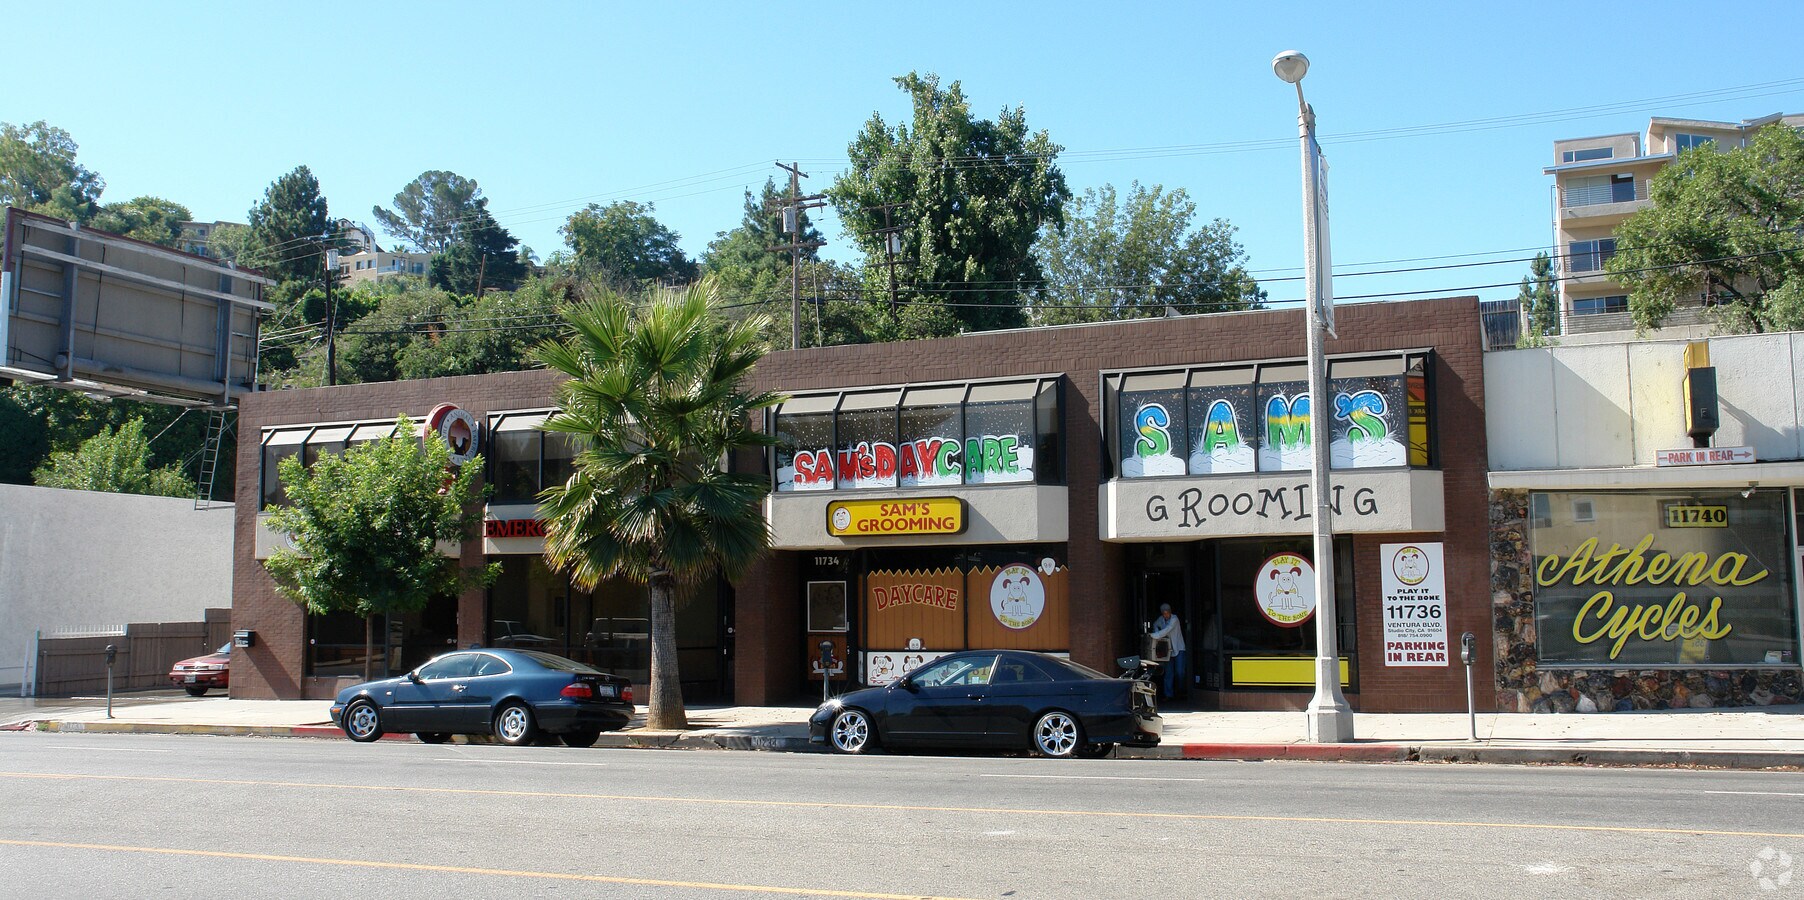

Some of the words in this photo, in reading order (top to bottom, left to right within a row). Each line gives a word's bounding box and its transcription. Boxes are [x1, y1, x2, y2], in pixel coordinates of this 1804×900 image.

[1134, 391, 1388, 458] SAM'S
[1668, 450, 1693, 463] PARK
[1695, 451, 1706, 462] IN
[1709, 449, 1735, 461] REAR
[880, 503, 930, 517] SAM'S
[1671, 508, 1726, 524] 11740
[857, 517, 955, 532] GROOMING
[815, 557, 839, 566] 11734
[1273, 556, 1289, 566] PLAY
[1291, 557, 1300, 566] IT
[1537, 533, 1770, 586] Athena
[873, 584, 959, 611] DAYCARE
[1387, 605, 1442, 619] 11736
[1573, 590, 1732, 660] Cycles
[1387, 642, 1445, 650] PARKING
[1387, 653, 1402, 662] IN
[1406, 653, 1446, 662] REAR
